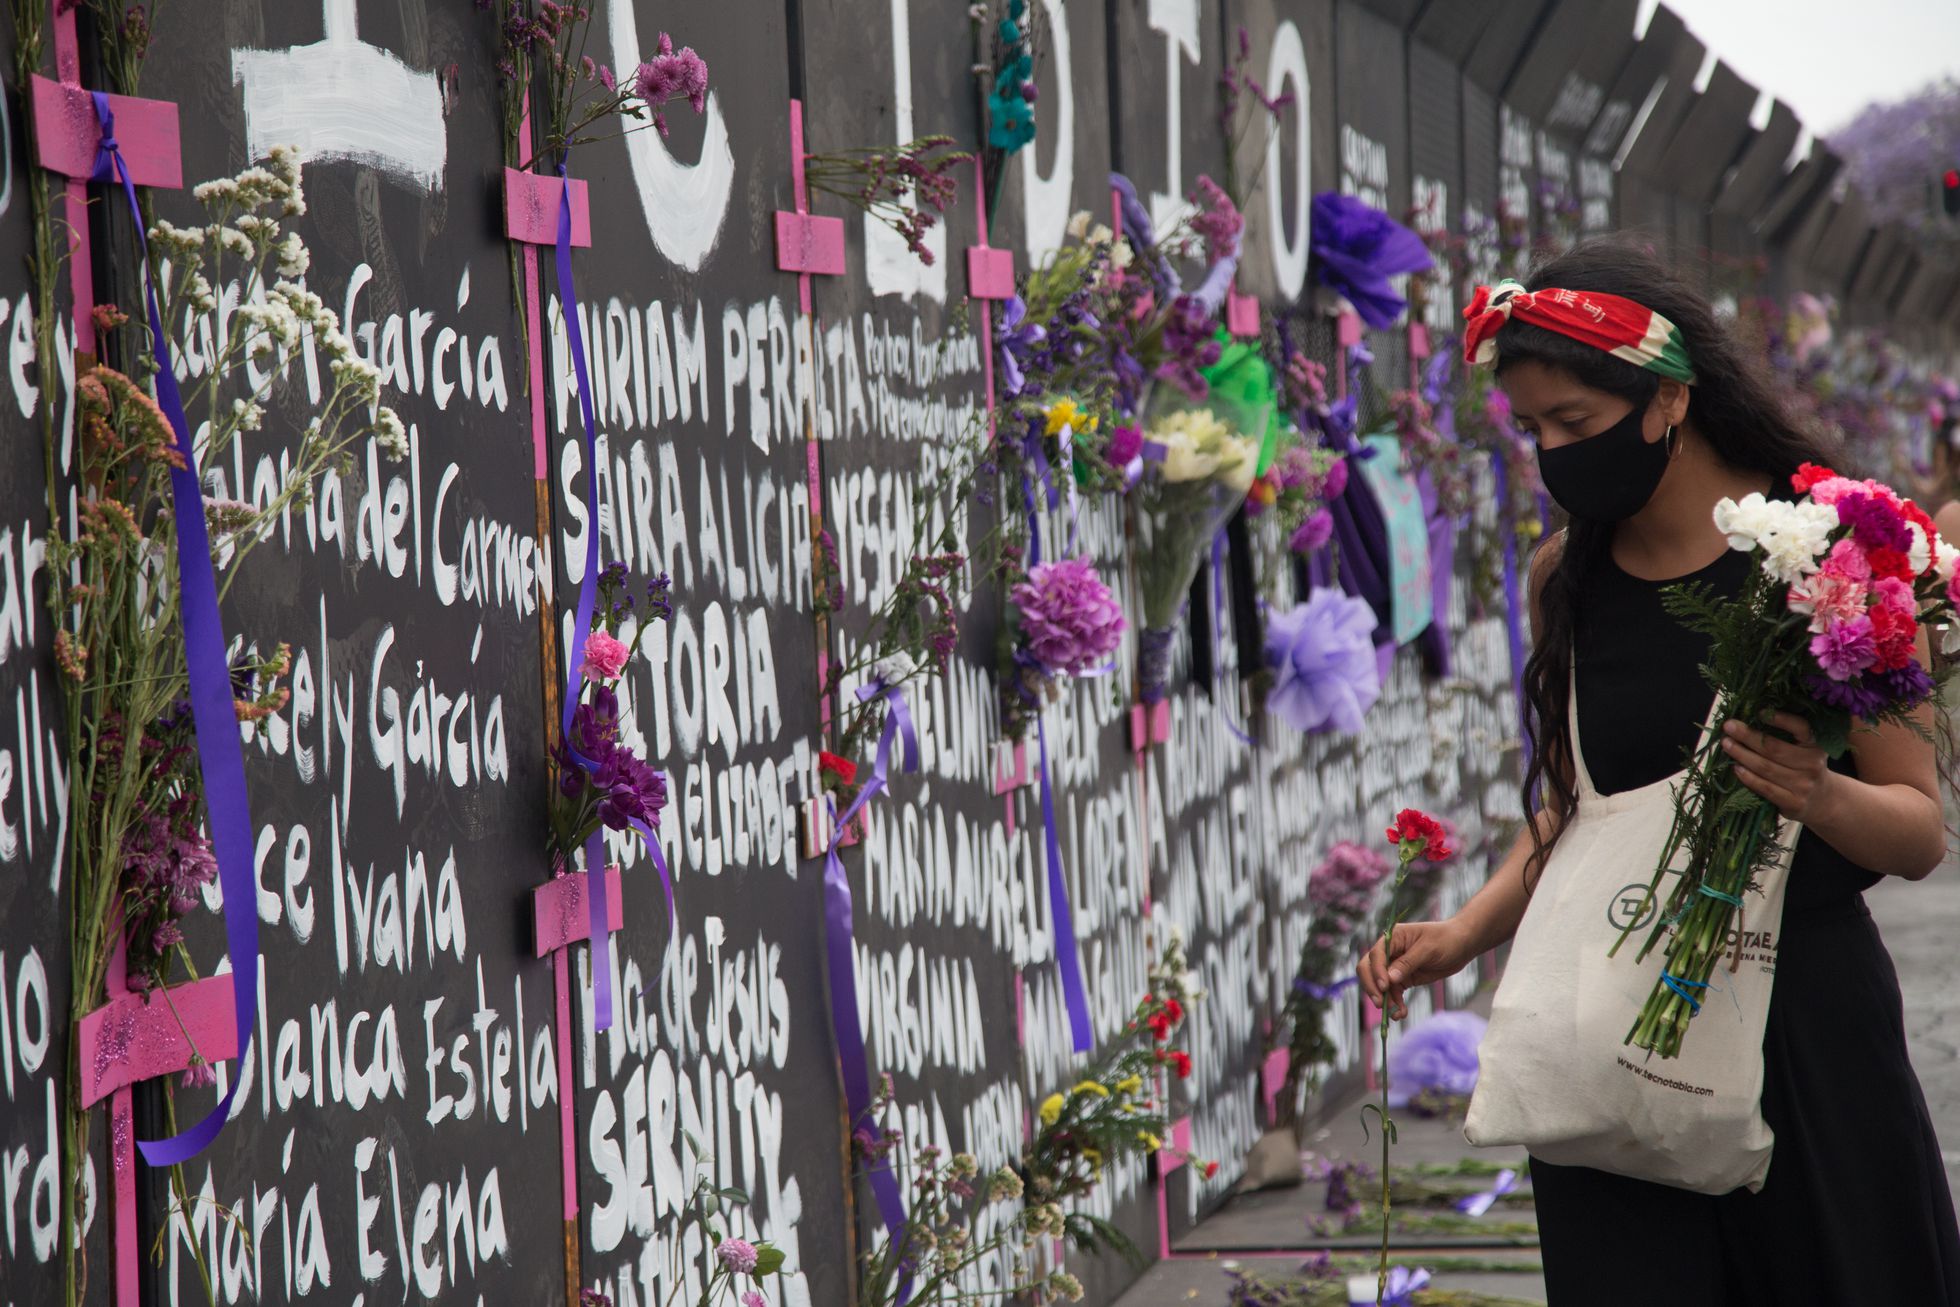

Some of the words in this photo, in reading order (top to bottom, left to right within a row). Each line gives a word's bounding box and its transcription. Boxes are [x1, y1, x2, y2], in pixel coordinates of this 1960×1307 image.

[343, 262, 509, 413] García
[722, 294, 870, 457] PERALTA
[356, 422, 422, 588] del
[560, 433, 694, 592] SAIRA
[699, 452, 814, 614] ALICIA
[366, 621, 509, 821] García
[331, 793, 466, 986] Ivana
[424, 954, 560, 1134] Estela
[850, 932, 985, 1081] VIRGINIA
[167, 1126, 331, 1307] María
[352, 1136, 511, 1307] Elena
